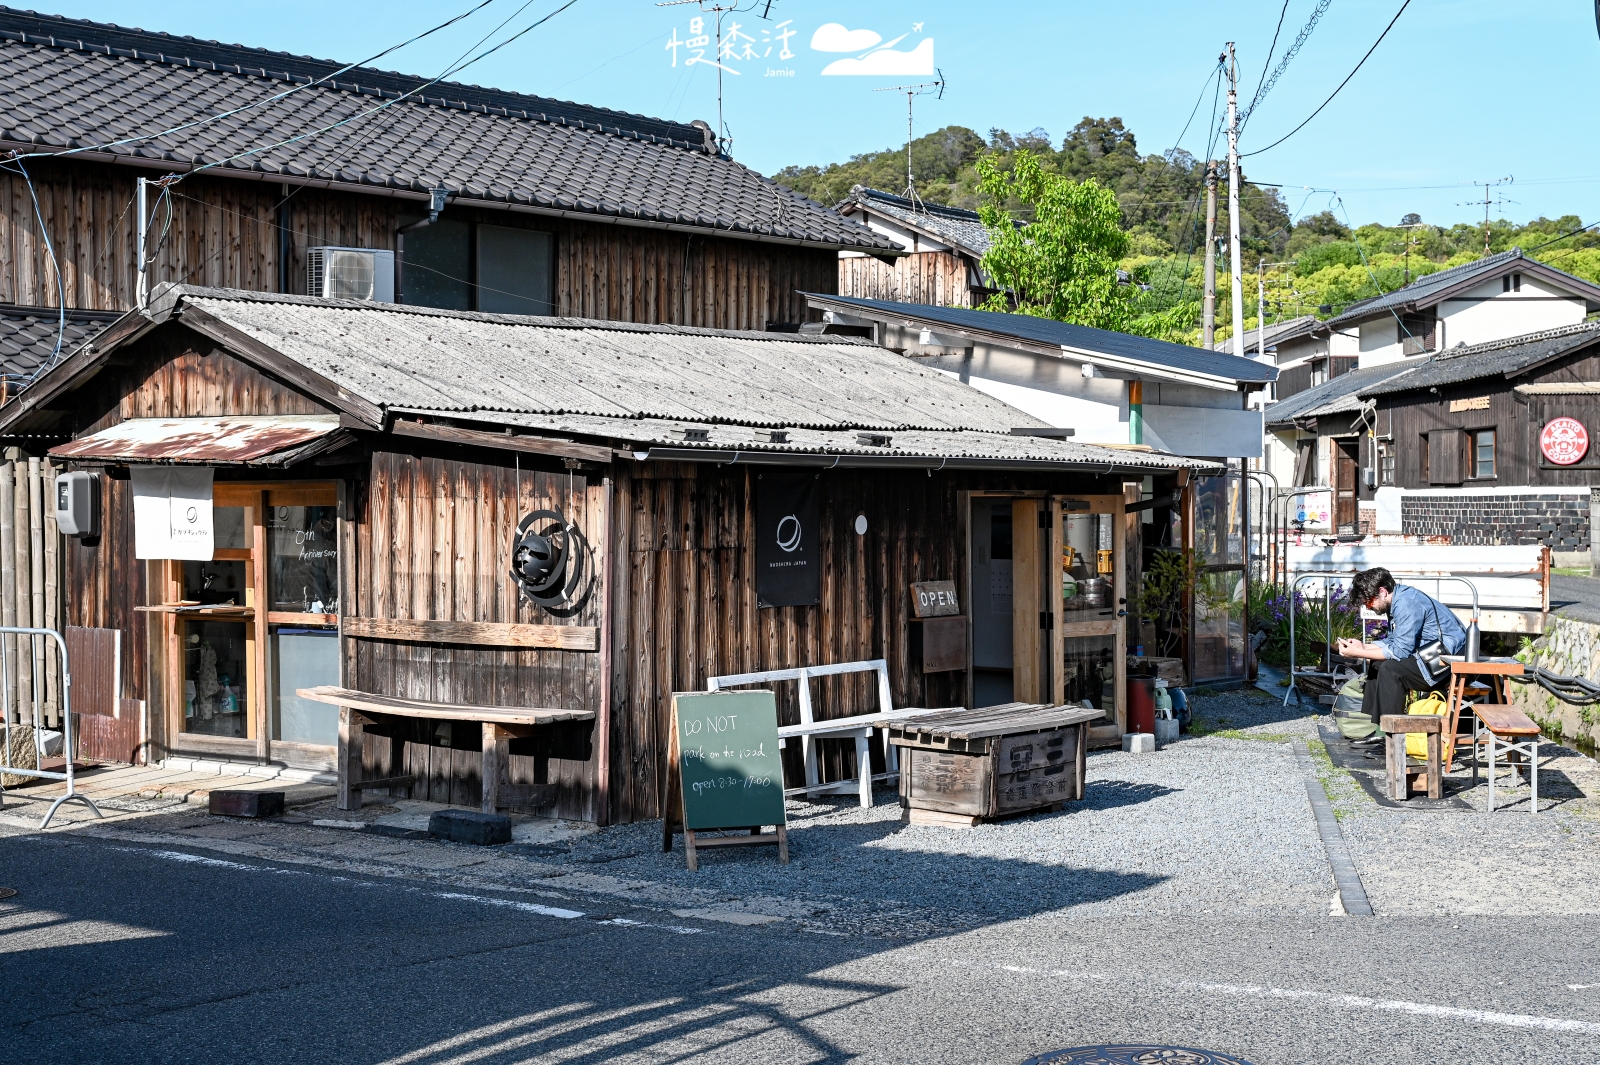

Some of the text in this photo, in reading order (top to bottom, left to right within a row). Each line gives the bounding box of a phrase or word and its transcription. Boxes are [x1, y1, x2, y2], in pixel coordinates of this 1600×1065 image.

[1550, 421, 1580, 432] AKAITO
[1548, 449, 1580, 461] COFFEE
[920, 590, 955, 607] OPEN
[684, 715, 737, 736] DO NOT
[683, 745, 706, 767] park
[709, 751, 720, 759] on
[723, 745, 735, 758] the
[692, 778, 716, 796] open
